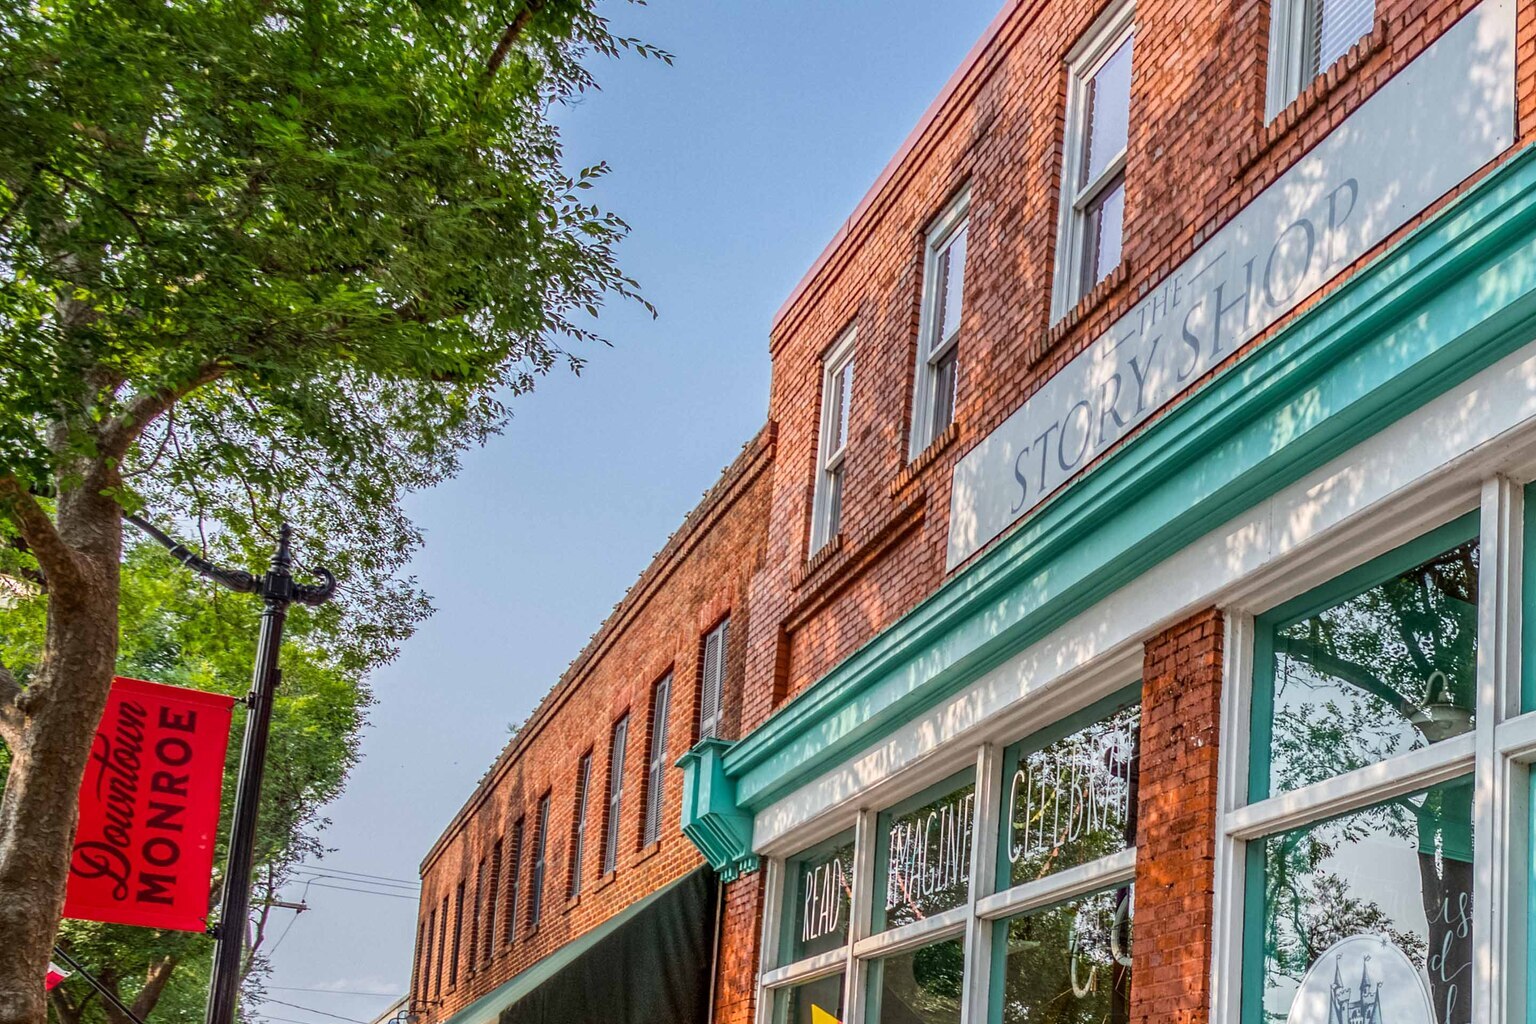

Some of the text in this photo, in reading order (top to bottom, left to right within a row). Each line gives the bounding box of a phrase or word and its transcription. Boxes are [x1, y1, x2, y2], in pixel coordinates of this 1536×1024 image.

[1010, 177, 1359, 515] STORY SHOP
[1136, 272, 1183, 337] THE
[70, 701, 148, 902] Downtown
[136, 705, 197, 906] MONROE
[885, 793, 975, 911] IMAGINE
[1008, 714, 1141, 863] CELEBRAT
[802, 859, 843, 942] READ
